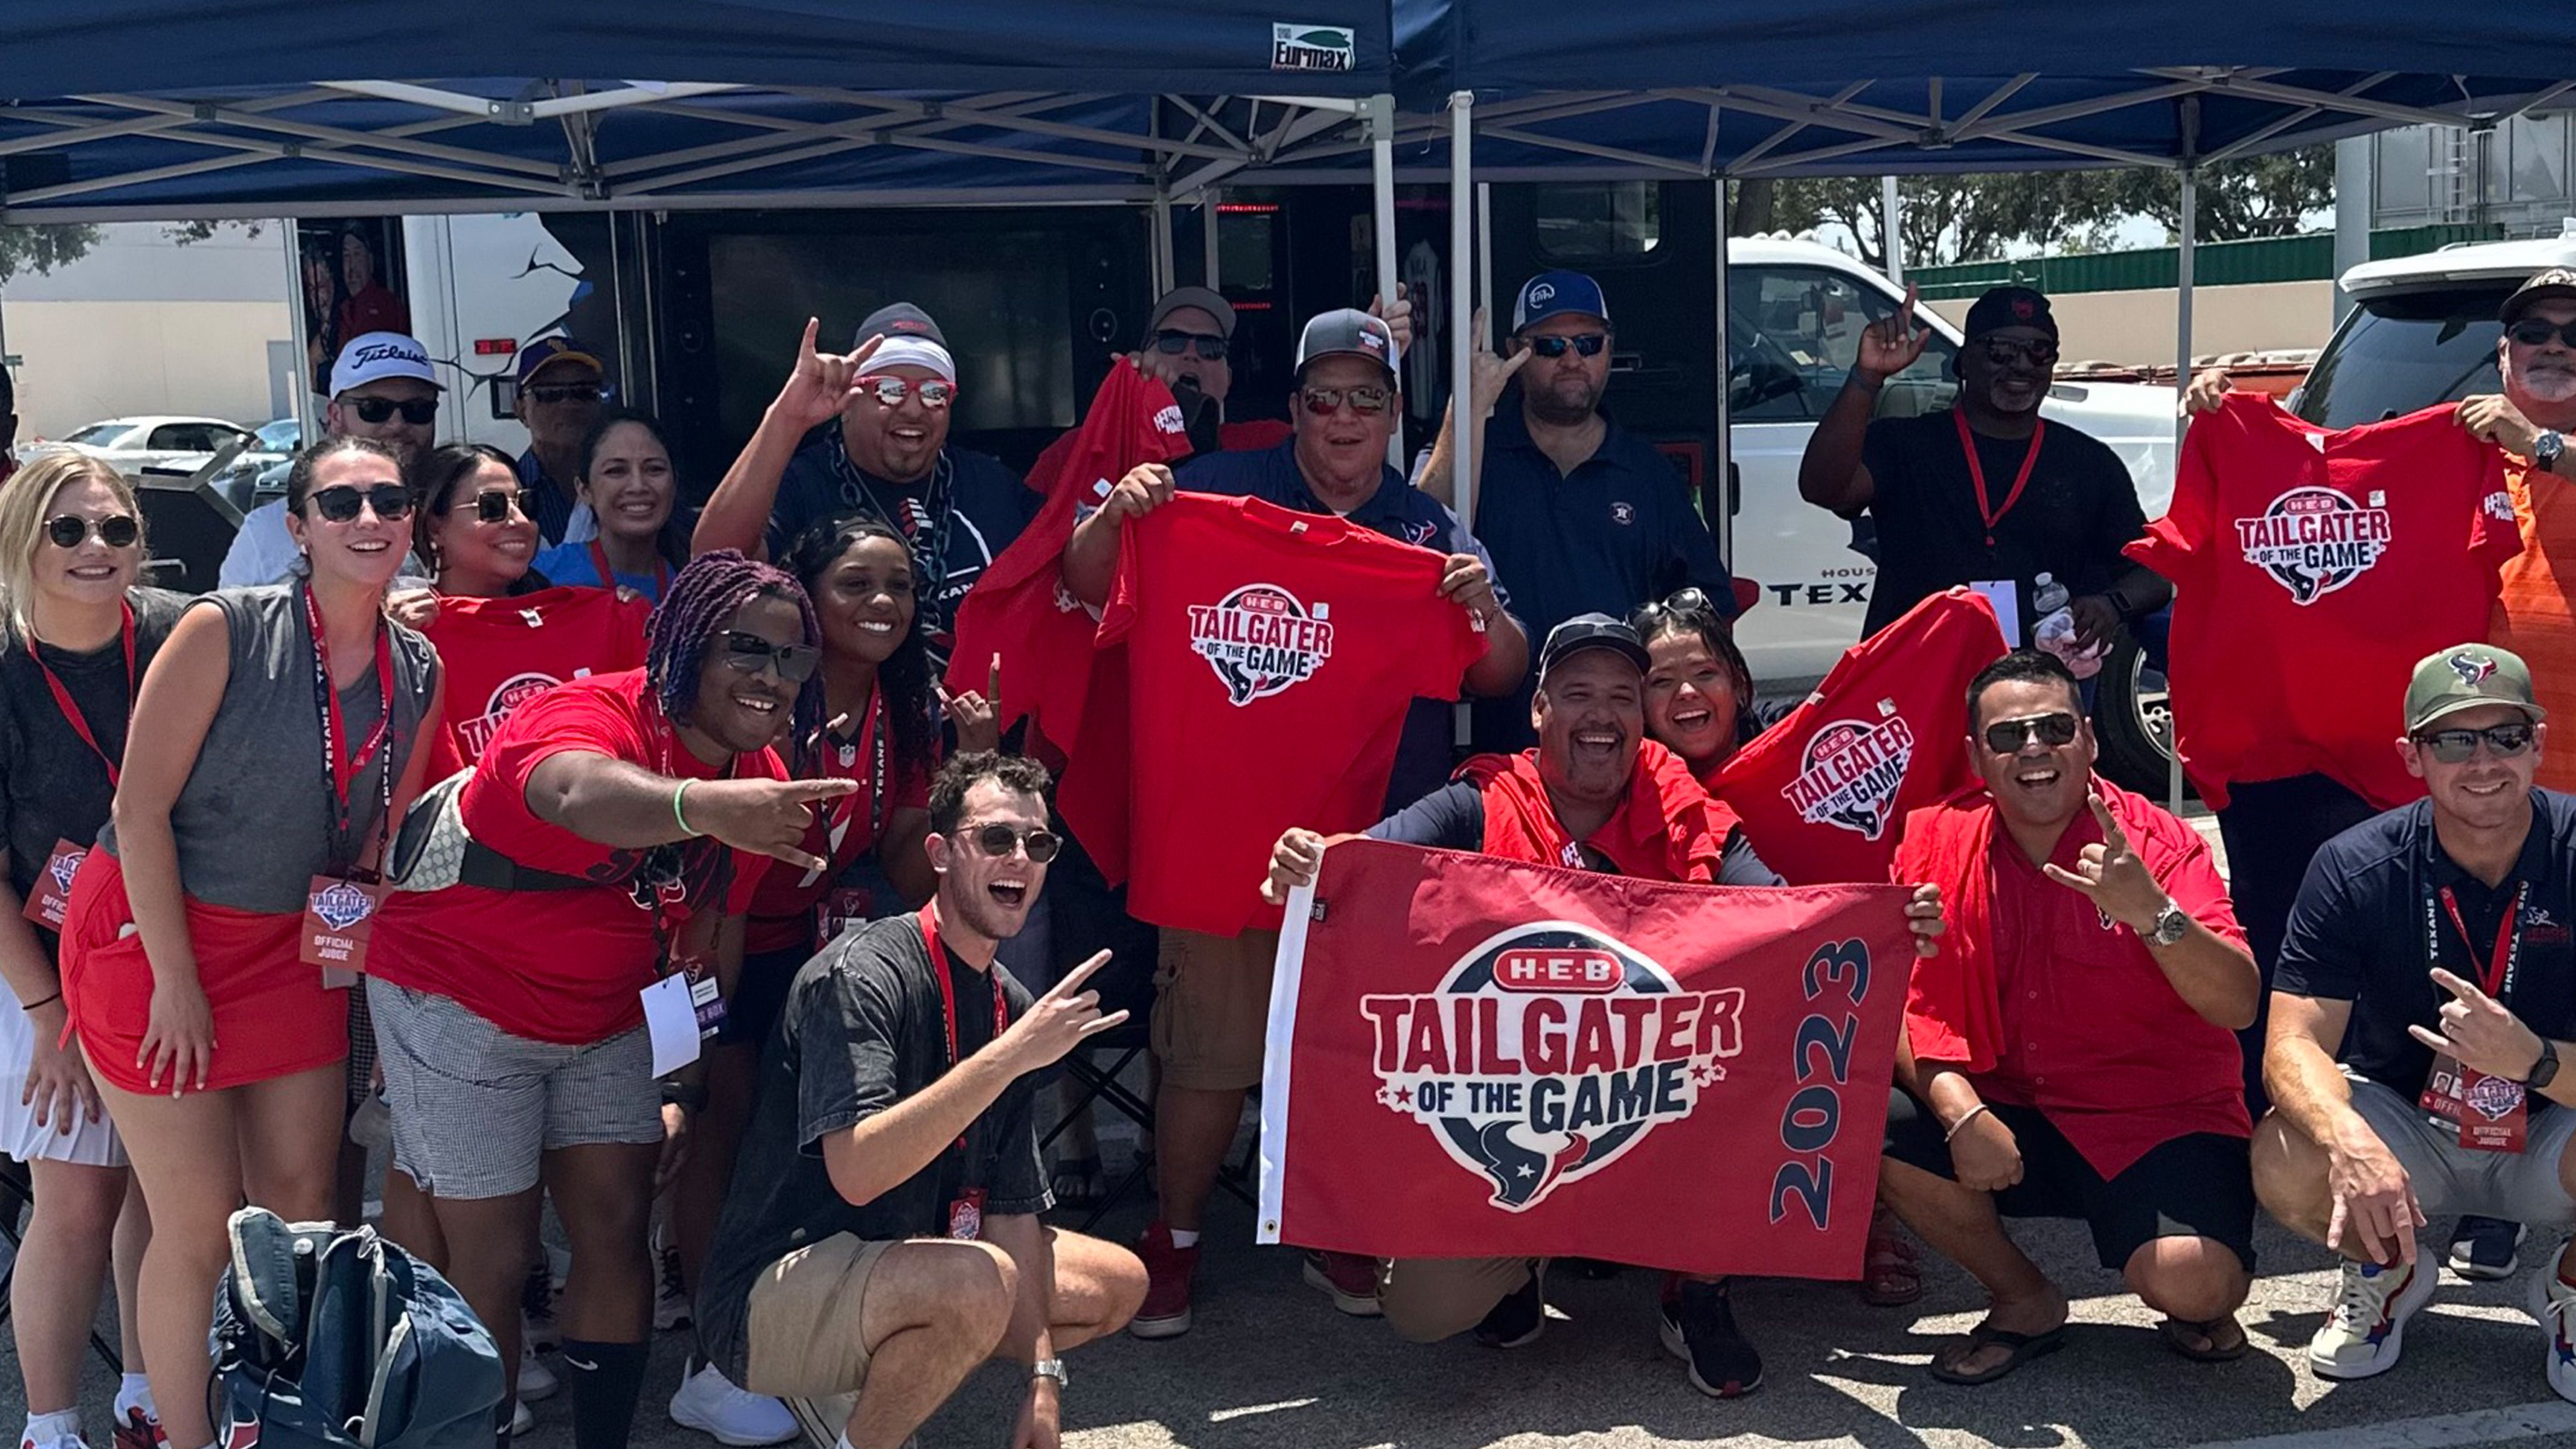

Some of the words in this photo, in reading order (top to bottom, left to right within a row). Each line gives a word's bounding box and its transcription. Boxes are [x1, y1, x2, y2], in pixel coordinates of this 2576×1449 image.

[1275, 41, 1347, 70] Eurmax
[2237, 511, 2389, 549] TAILGATER
[2259, 551, 2274, 562] OF
[2279, 548, 2302, 560] THE
[2304, 542, 2372, 569] GAME
[1767, 583, 1868, 606] TEX
[1821, 568, 1876, 578] HOUS
[1190, 608, 1331, 654] TAILGATER
[1207, 642, 1220, 655] OF
[1225, 645, 1245, 658] THE
[1246, 646, 1309, 677] GAME
[322, 707, 333, 772] TEXANS
[876, 739, 884, 797] TEXANS
[1782, 718, 1911, 813] TAILGATER
[383, 742, 391, 806] TEXANS
[1816, 803, 1831, 818] OF
[1831, 789, 1851, 808] THE
[1850, 753, 1906, 803] GAME
[314, 935, 354, 950] OFFICIAL
[2427, 898, 2438, 960] TEXANS
[1510, 958, 1611, 982] H-E-B
[2504, 932, 2520, 993] TEXANS
[1365, 991, 1741, 1075] TAILGATER
[1418, 1082, 1455, 1113] OF
[1466, 1082, 1523, 1113] THE
[1529, 1059, 1690, 1135] GAME
[1770, 937, 1871, 1231] 2023
